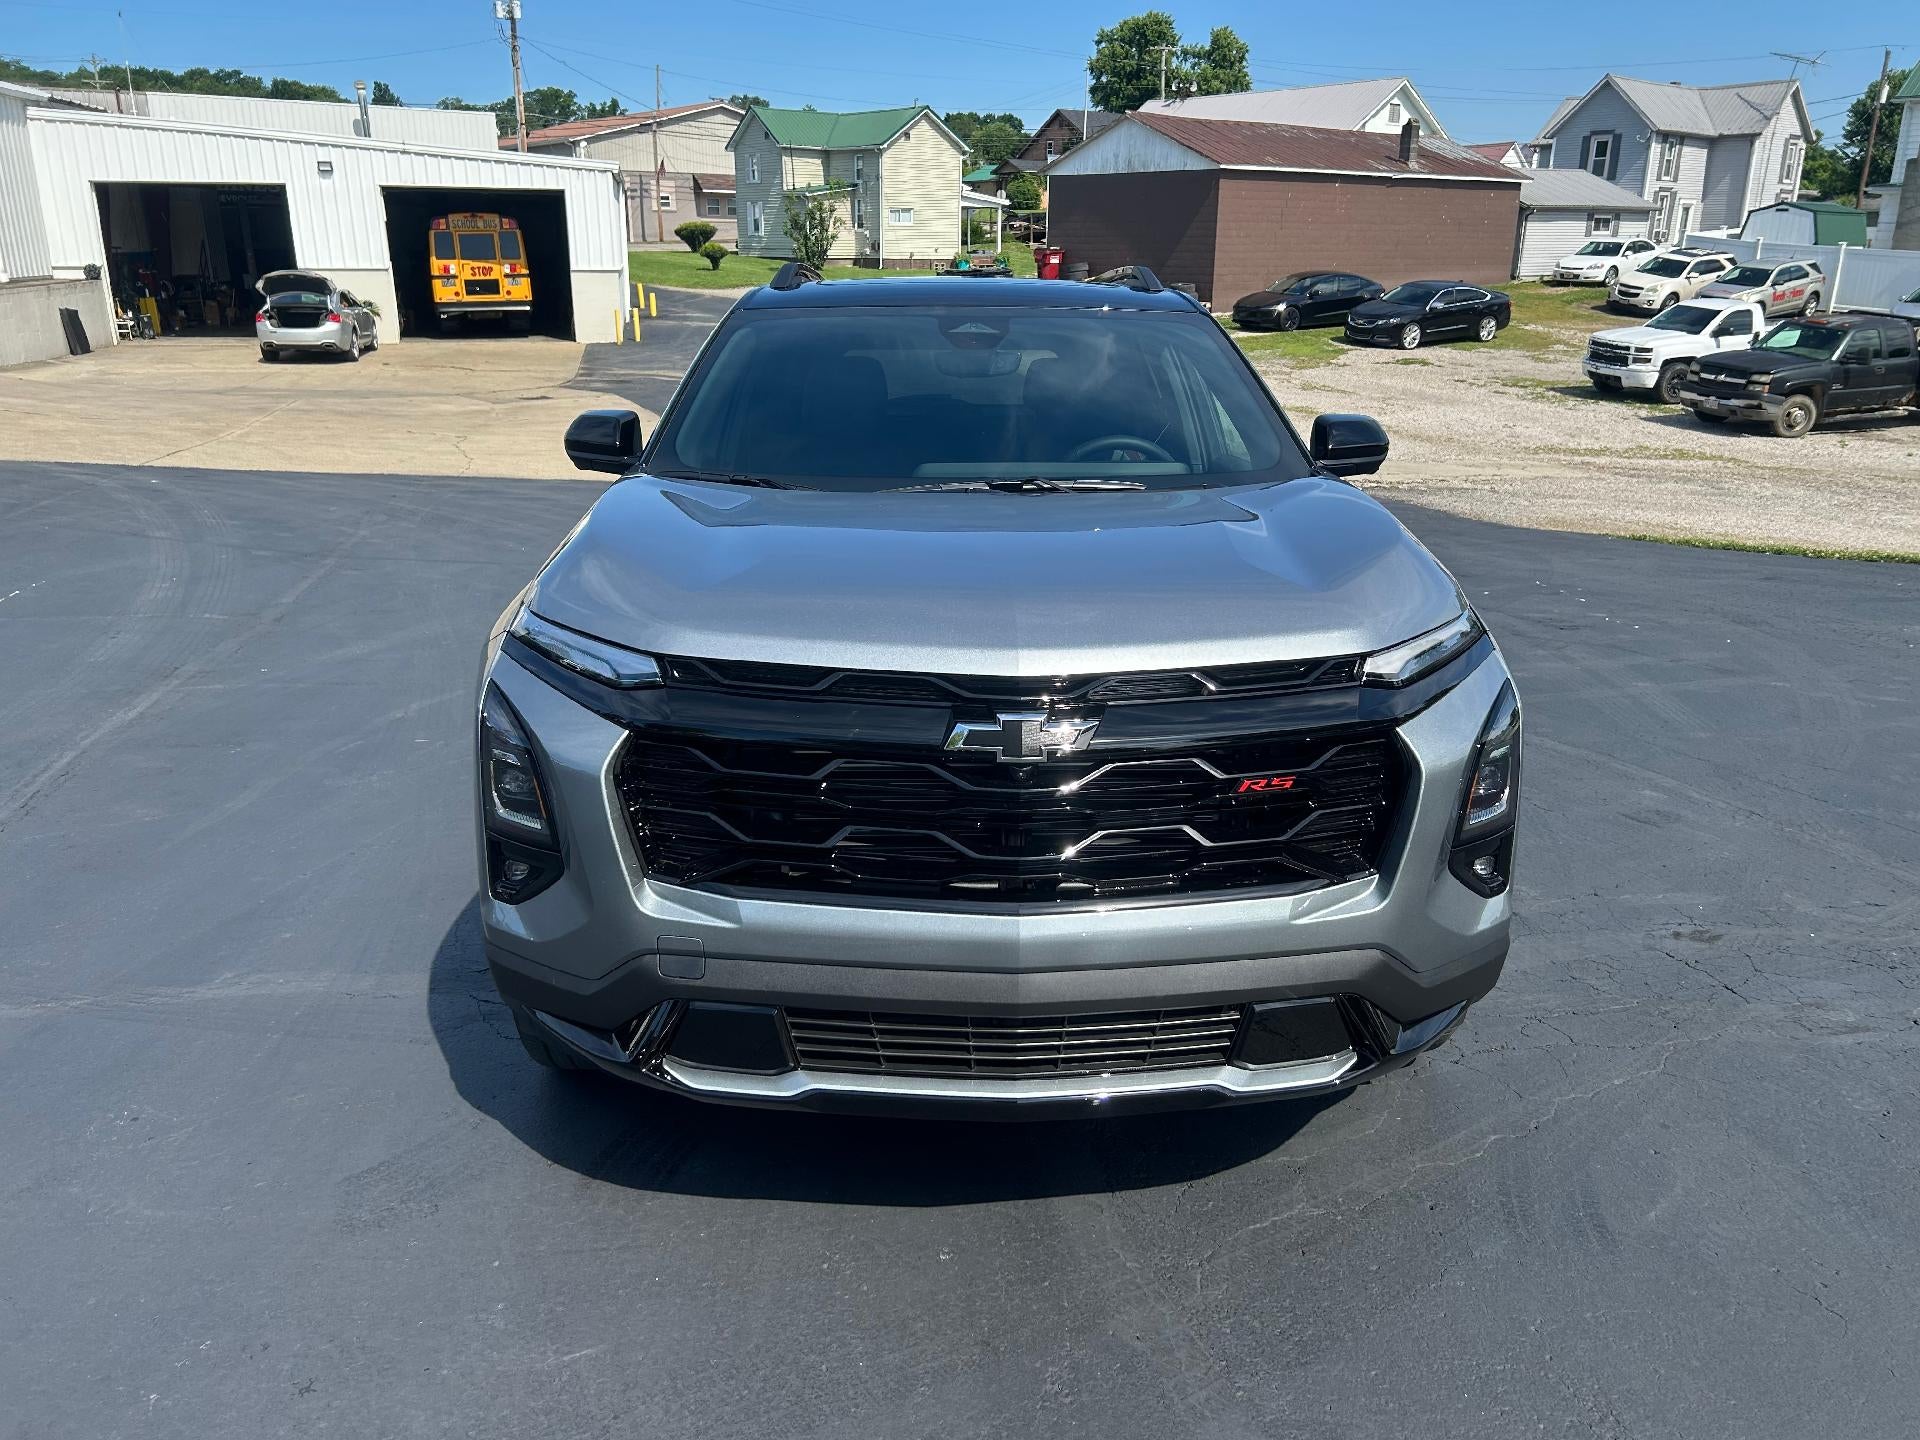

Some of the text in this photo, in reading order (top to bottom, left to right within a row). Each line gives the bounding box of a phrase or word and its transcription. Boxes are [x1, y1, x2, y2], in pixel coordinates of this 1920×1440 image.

[452, 219, 497, 229] SCHOOL BUS
[470, 265, 494, 277] STOP
[1237, 775, 1297, 792] RS
